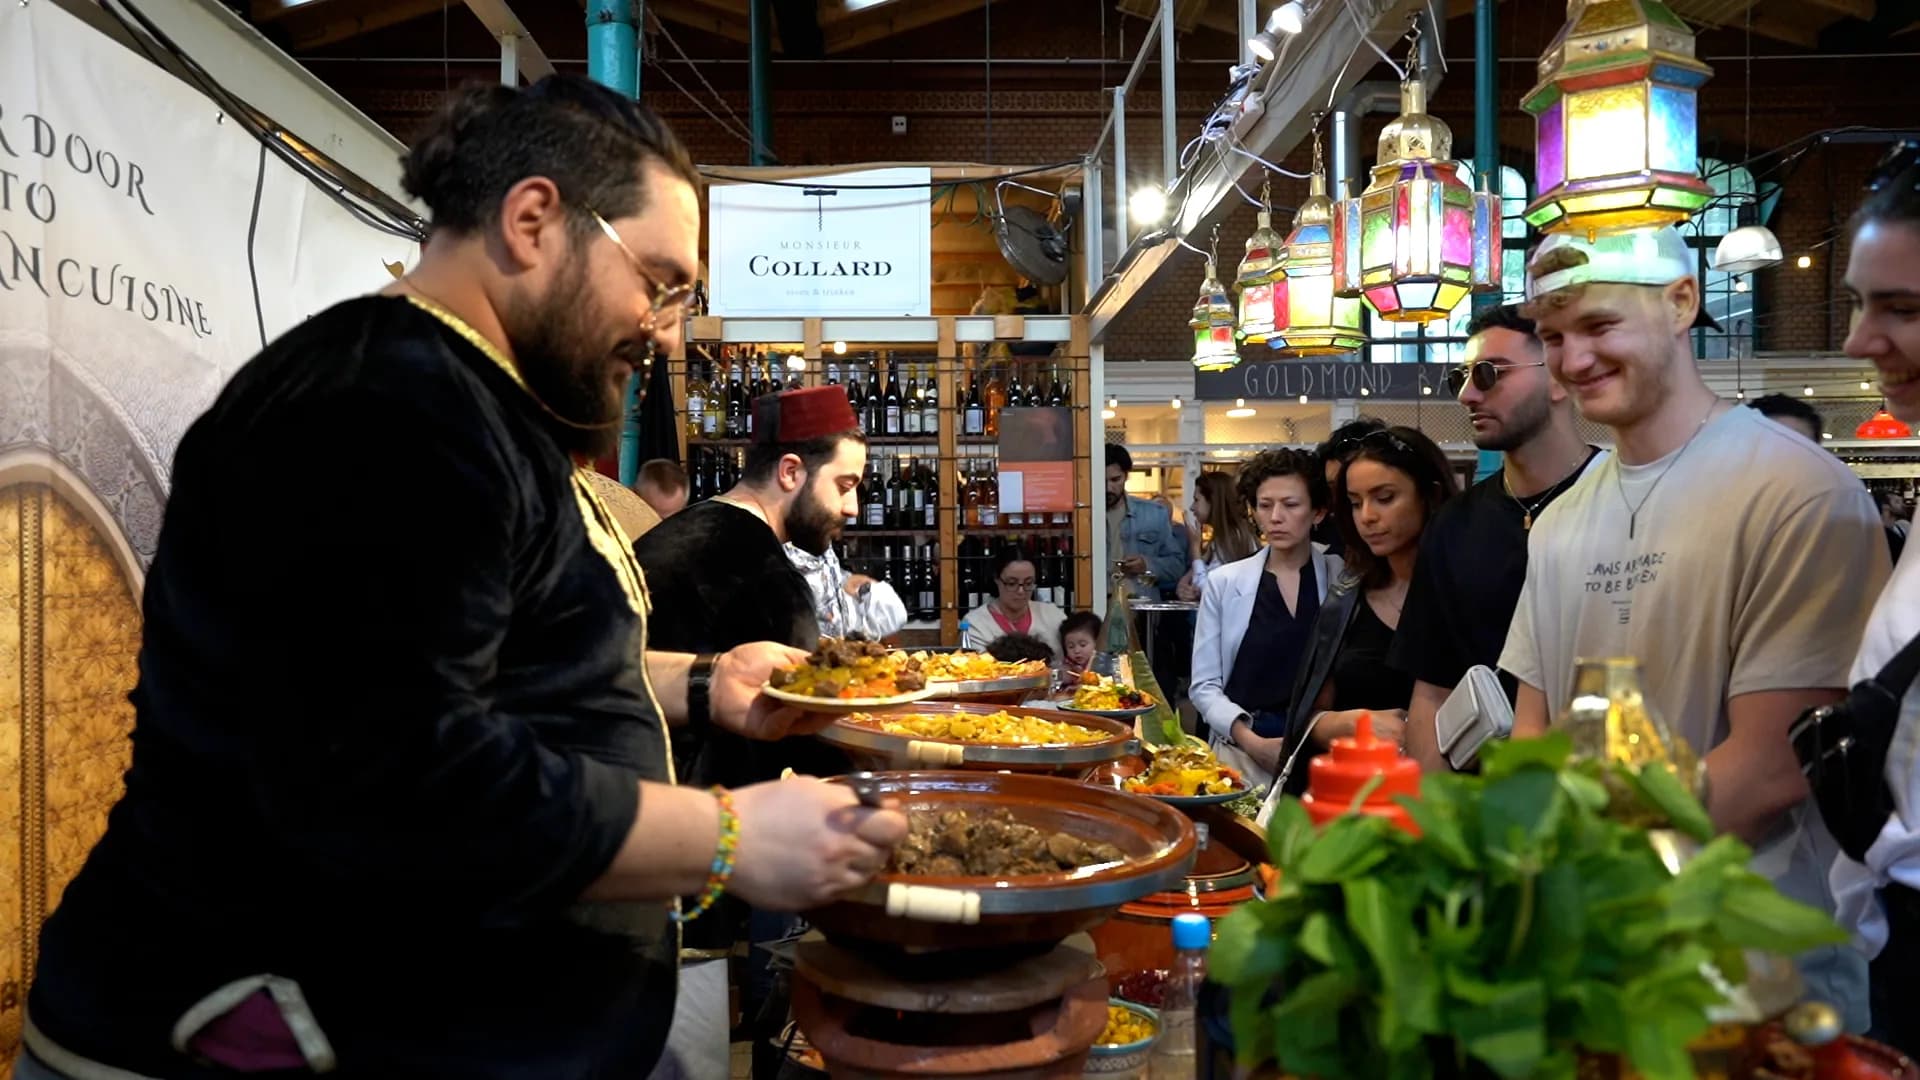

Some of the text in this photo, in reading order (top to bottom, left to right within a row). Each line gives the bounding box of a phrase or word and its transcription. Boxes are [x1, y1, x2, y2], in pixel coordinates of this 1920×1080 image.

[22, 114, 154, 215] DOOR
[0, 169, 56, 223] TO
[780, 241, 862, 250] MONSIEUR
[0, 230, 212, 338] N CUISINE
[1244, 364, 1392, 397] GOLDMOND
[1584, 582, 1601, 593] TO
[1605, 581, 1621, 594] BE
